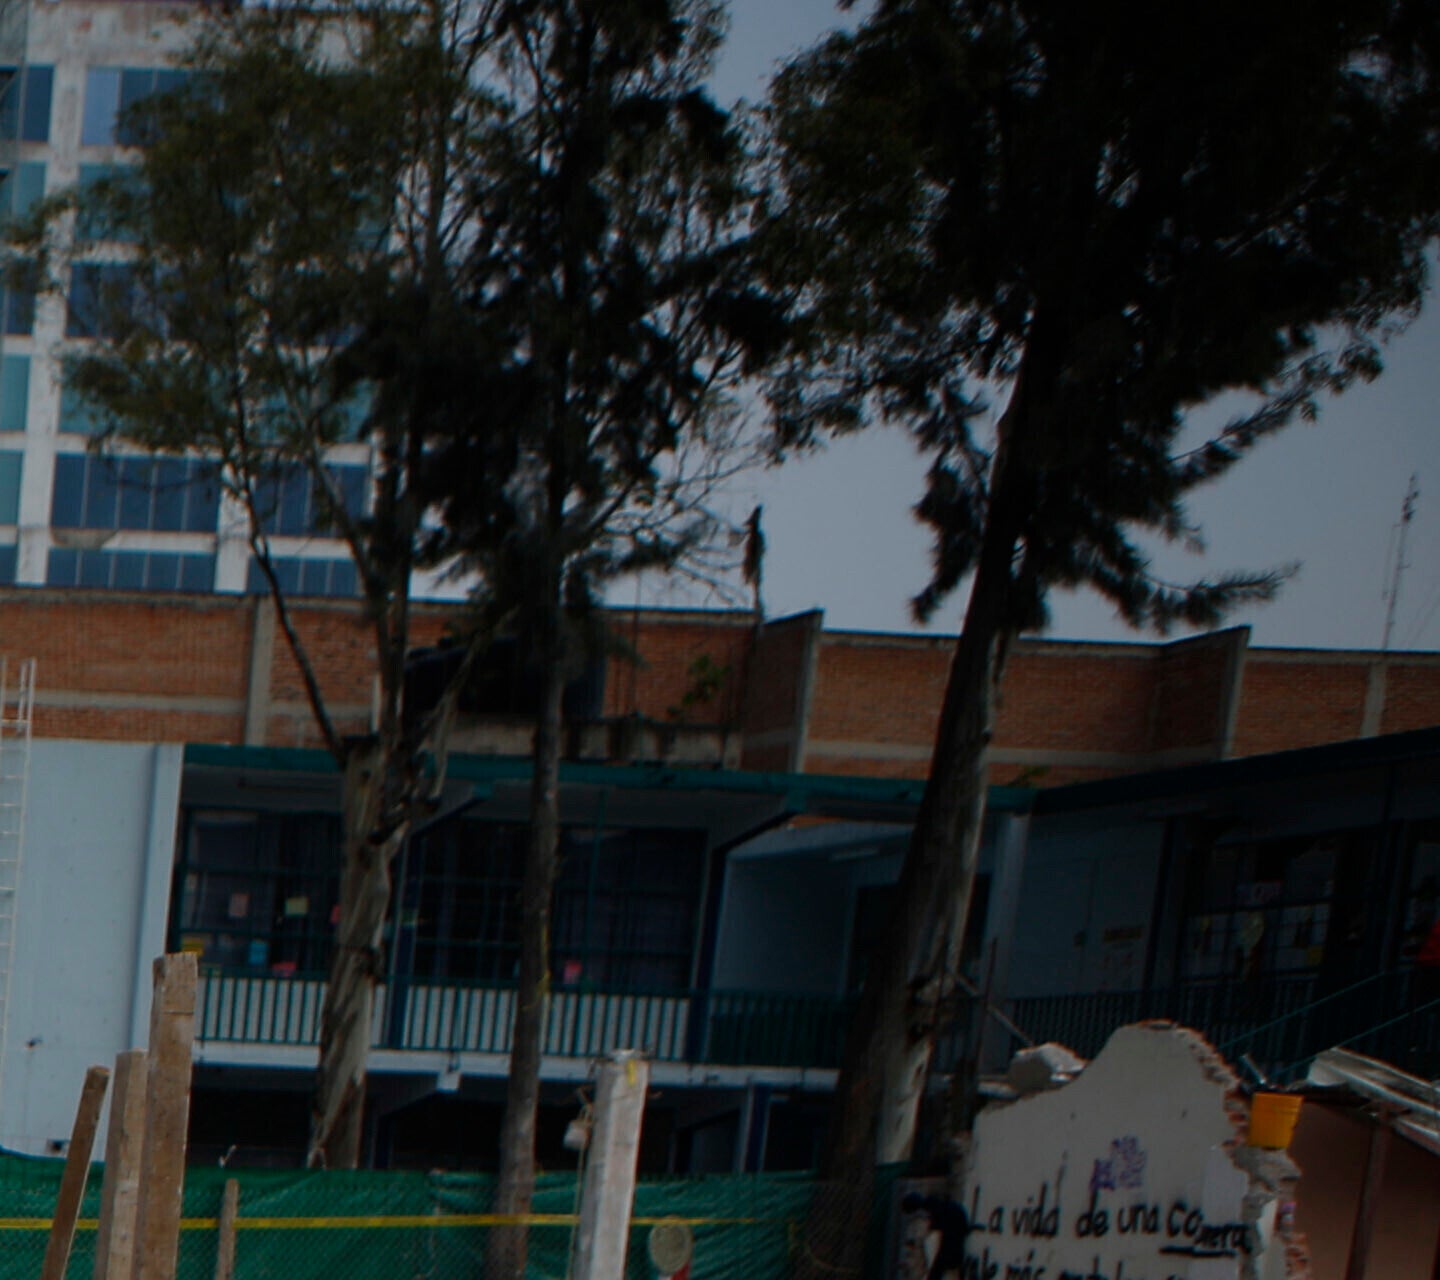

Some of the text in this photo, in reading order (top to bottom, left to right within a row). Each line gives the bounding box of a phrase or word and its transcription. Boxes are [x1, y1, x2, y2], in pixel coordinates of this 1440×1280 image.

[967, 1184, 1003, 1234] La
[1011, 1181, 1061, 1238] vida
[1075, 1186, 1110, 1238] de
[1117, 1202, 1160, 1236] una
